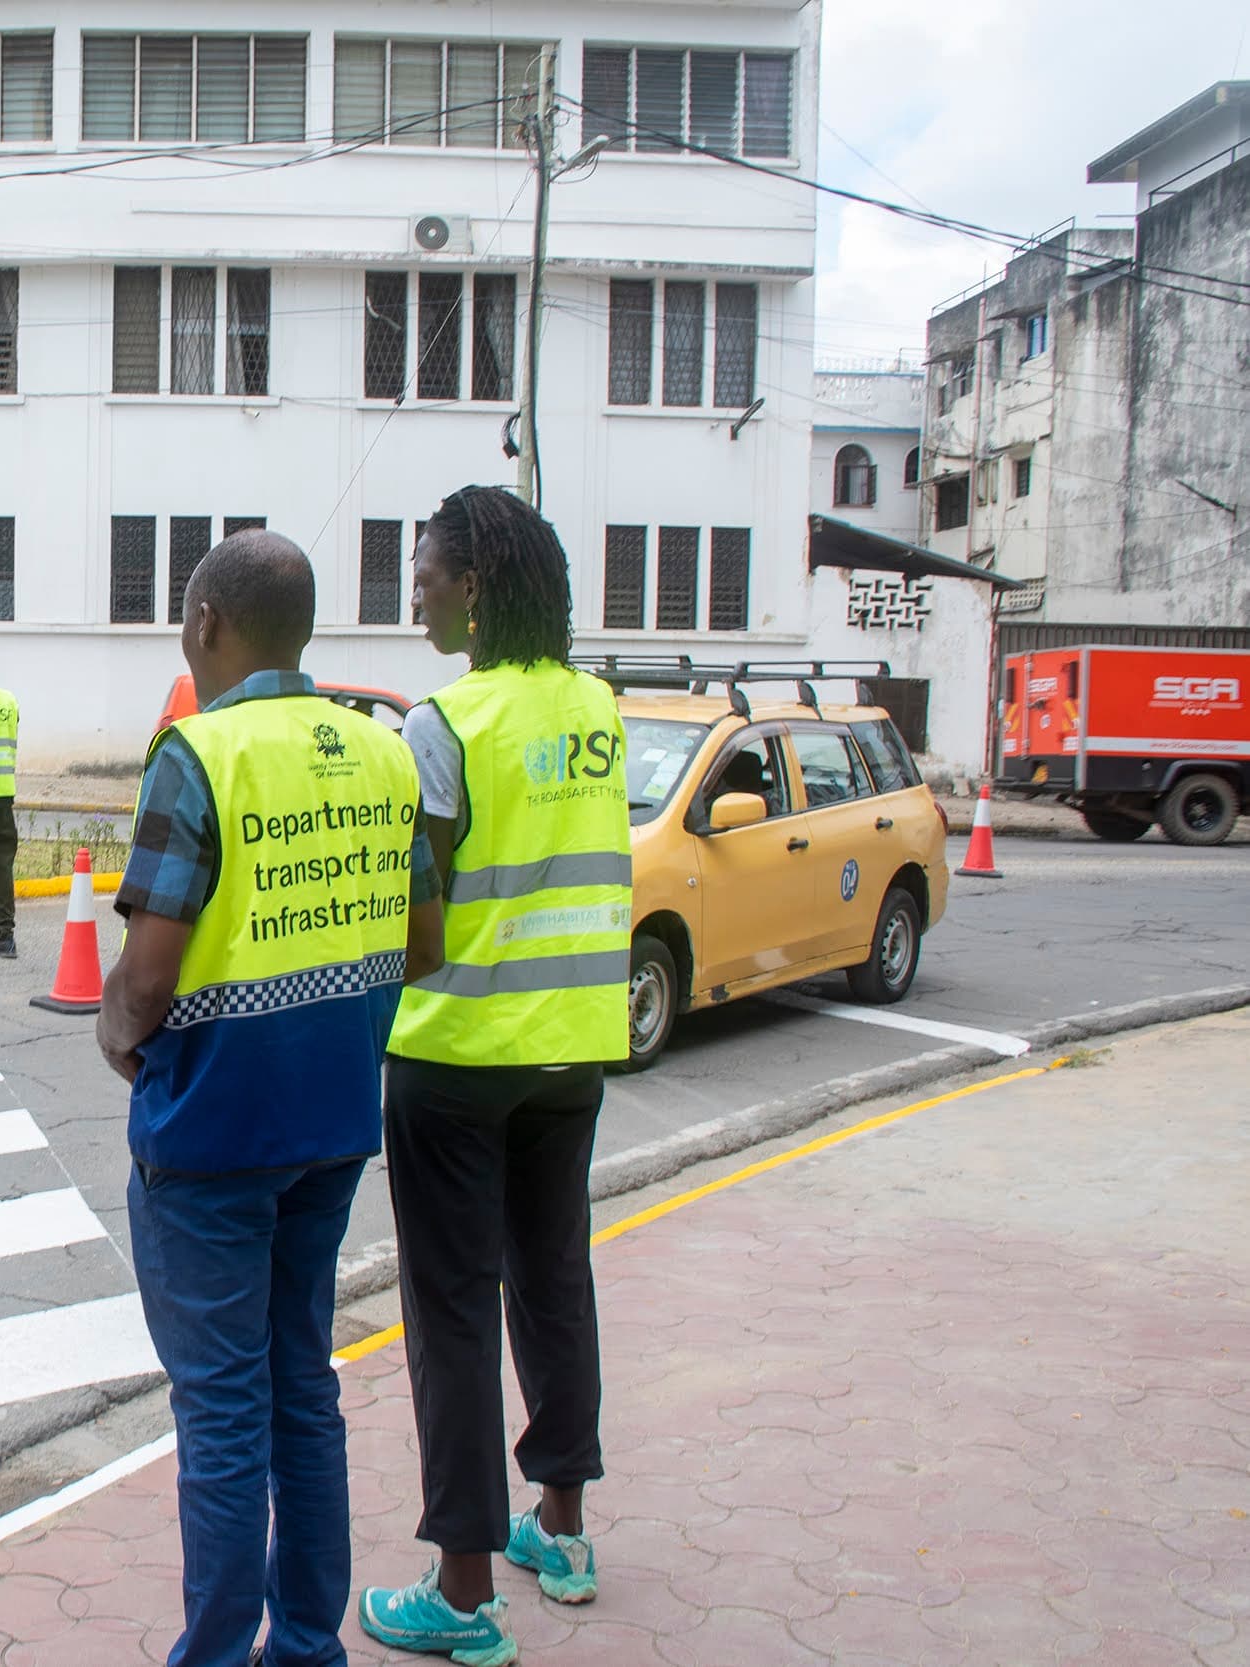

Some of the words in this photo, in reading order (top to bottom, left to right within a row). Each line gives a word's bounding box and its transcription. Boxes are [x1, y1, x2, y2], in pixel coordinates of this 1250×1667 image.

[1152, 676, 1240, 701] SGA
[242, 796, 391, 844] Department
[400, 803, 415, 825] o
[250, 891, 406, 942] infrastrcture
